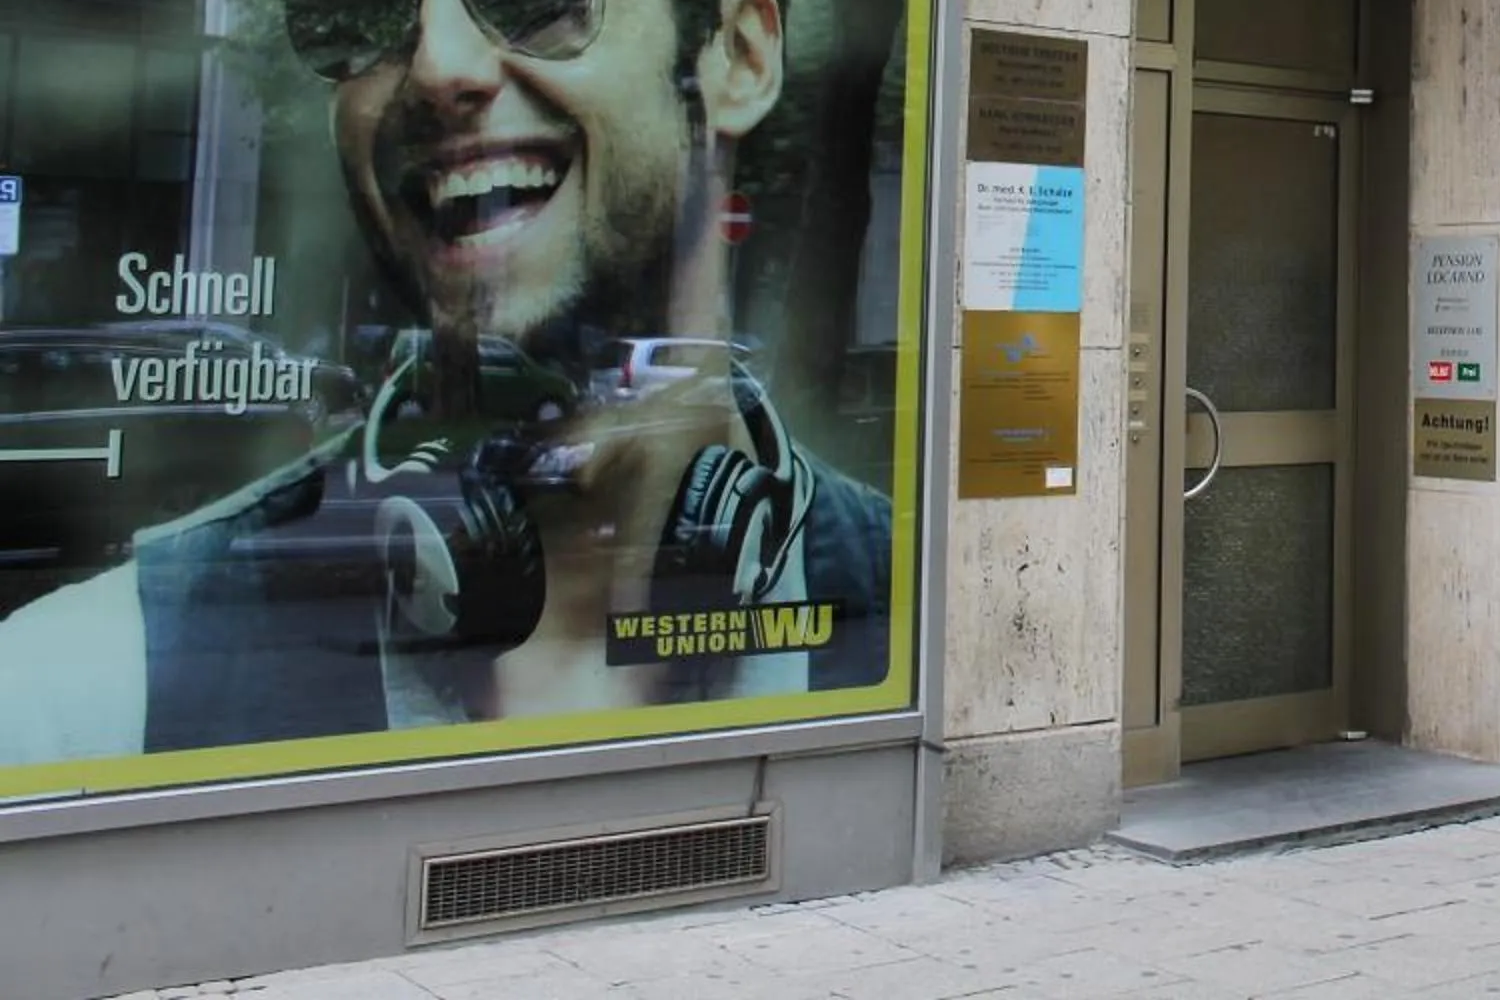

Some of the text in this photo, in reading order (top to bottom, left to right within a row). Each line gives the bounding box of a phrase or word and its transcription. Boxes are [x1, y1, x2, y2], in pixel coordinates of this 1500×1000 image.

[1432, 254, 1484, 268] PENSION
[115, 253, 275, 317] Schnell
[1426, 270, 1486, 285] LOCARNO
[112, 343, 320, 414] verfügbar
[1421, 412, 1489, 434] Achtung!
[615, 609, 747, 639] WESTERN
[762, 604, 833, 648] WU
[657, 631, 747, 657] UNION
